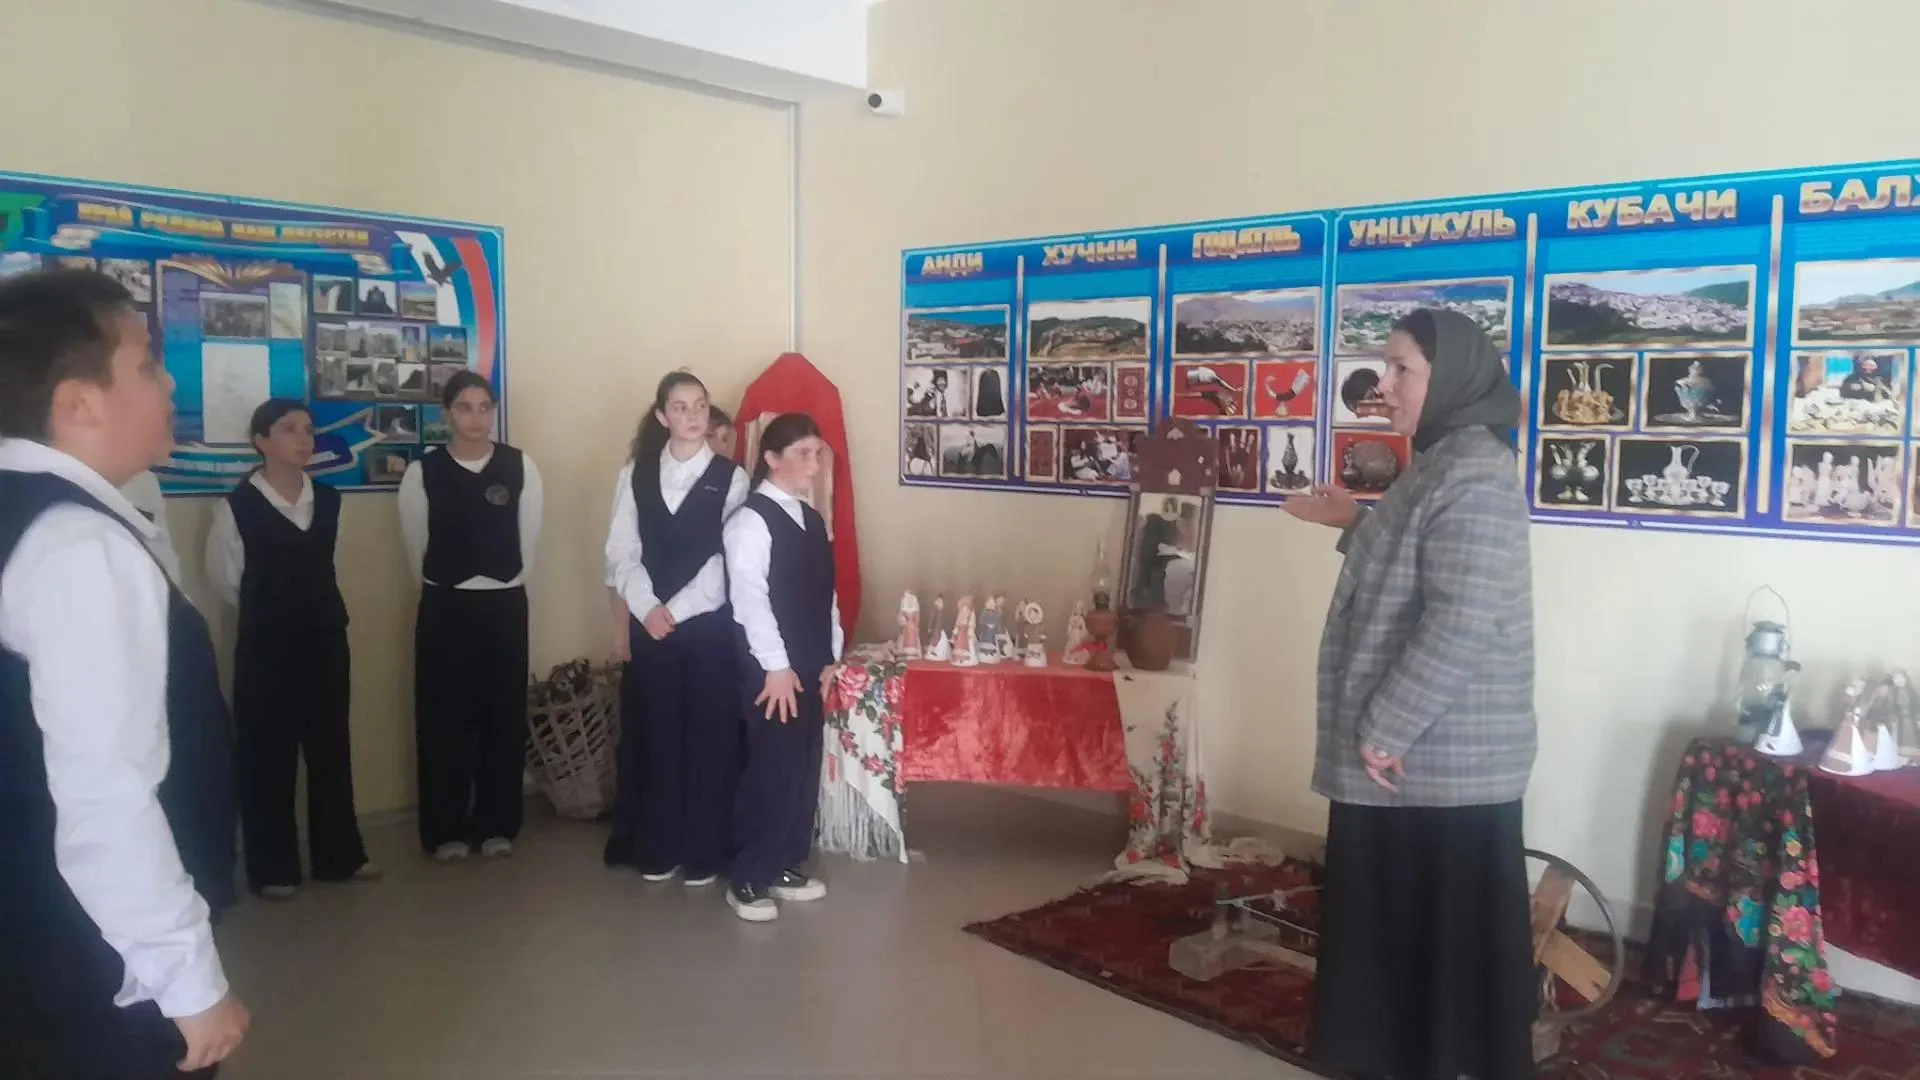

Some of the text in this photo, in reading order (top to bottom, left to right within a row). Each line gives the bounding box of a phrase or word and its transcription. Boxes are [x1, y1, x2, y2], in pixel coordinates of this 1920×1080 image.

[1567, 188, 1737, 230] КУБАЧИ
[1799, 174, 1920, 214] БАЛ
[1349, 208, 1516, 247] УНЦУКУЛЬ
[921, 252, 983, 277] АНДИ
[1042, 239, 1137, 266] ХУЧНИ
